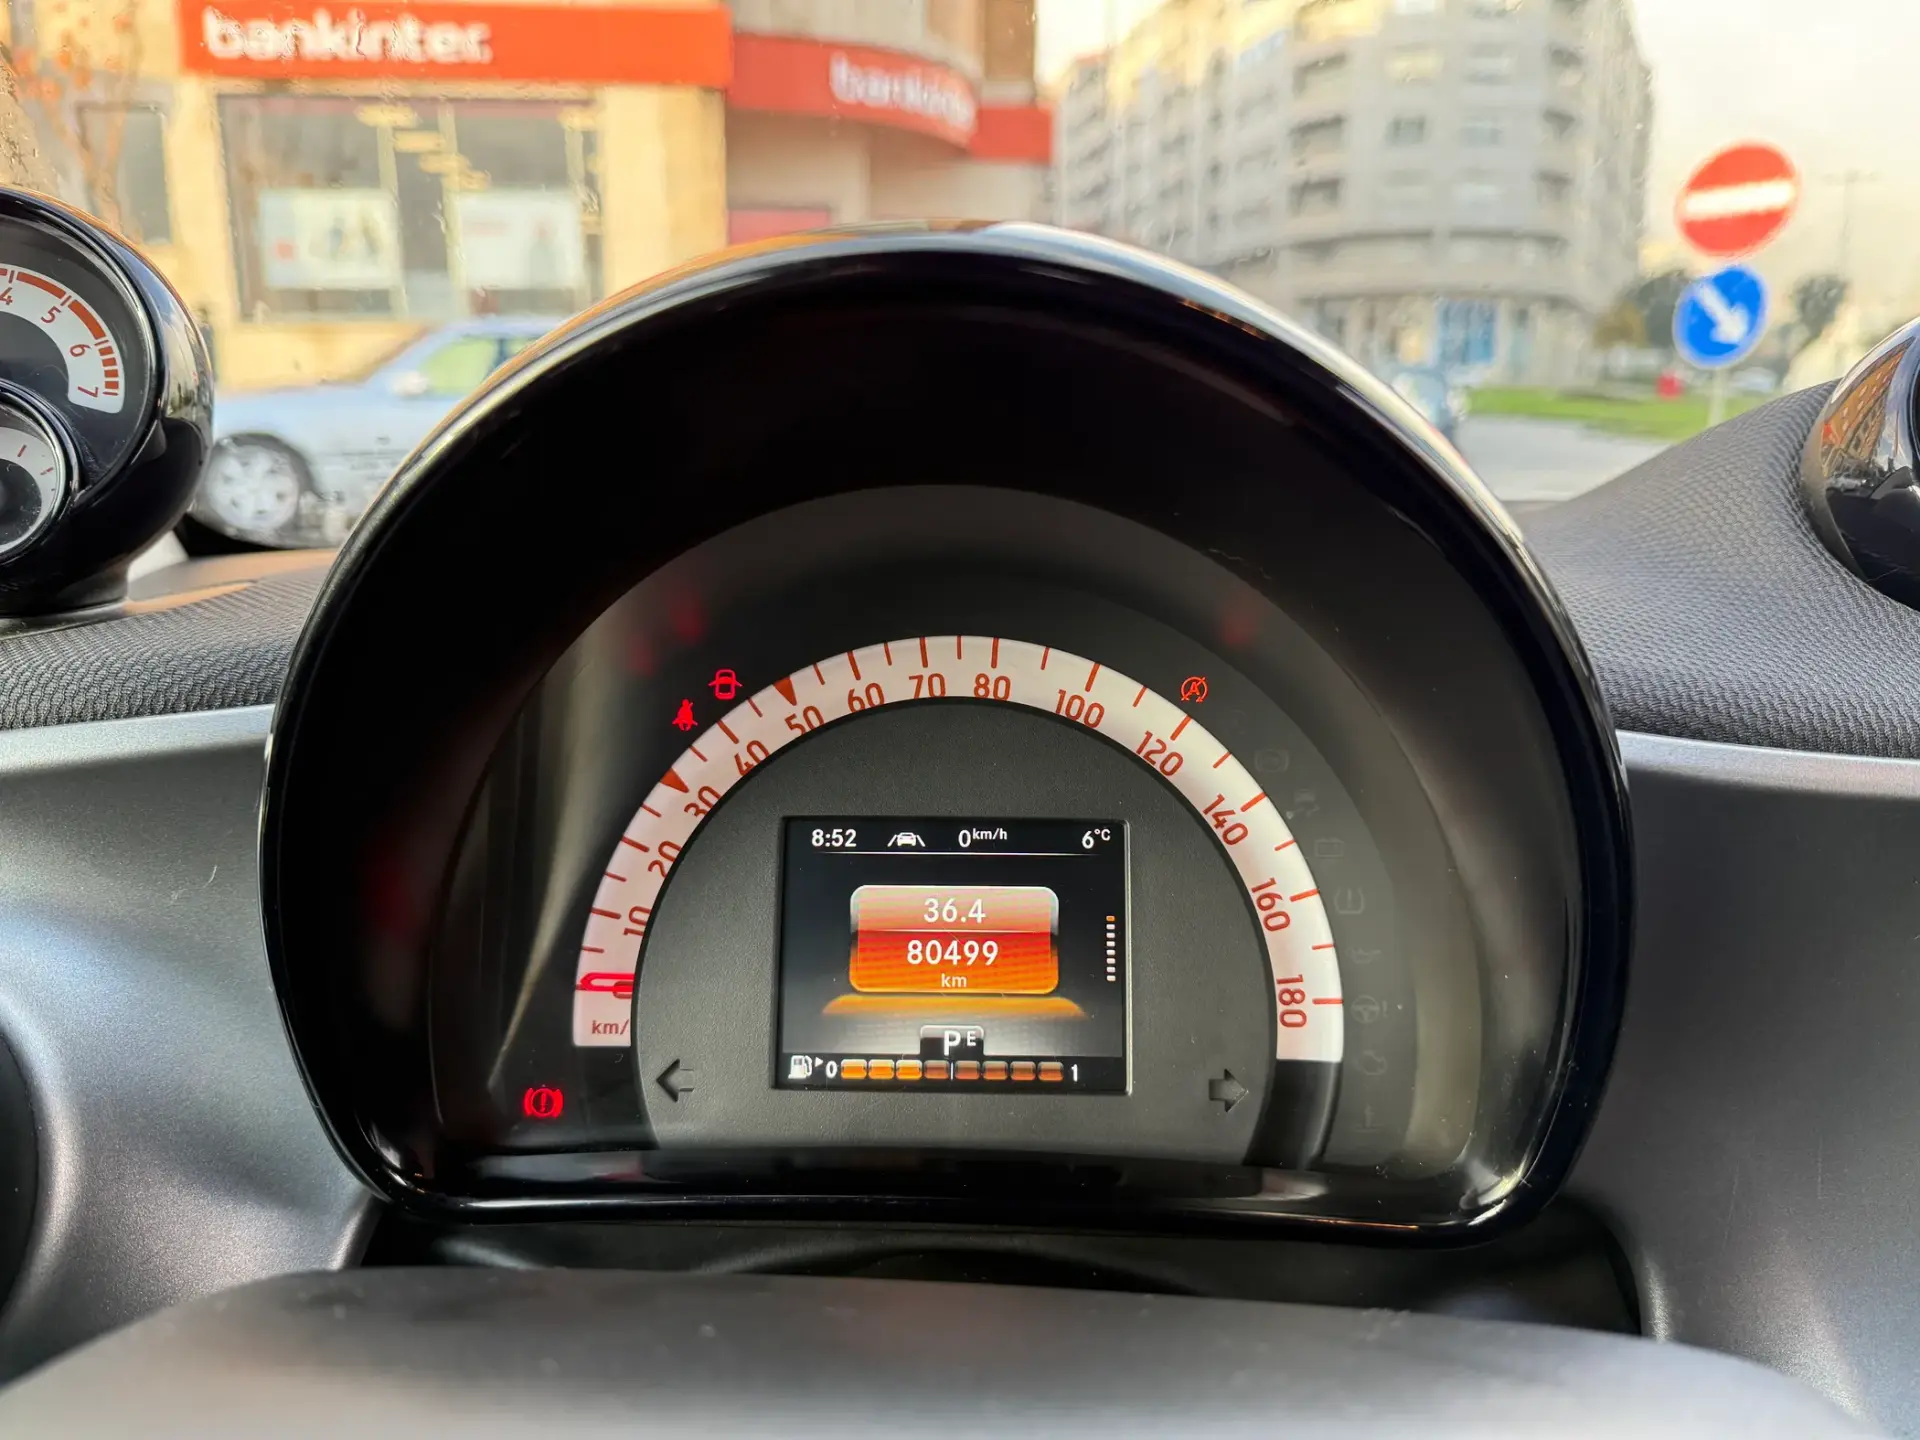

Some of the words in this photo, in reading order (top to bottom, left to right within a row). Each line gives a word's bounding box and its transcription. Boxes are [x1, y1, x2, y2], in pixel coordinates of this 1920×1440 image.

[40, 305, 61, 324] 5
[69, 343, 91, 357] 6
[77, 385, 99, 398] 7
[848, 682, 886, 713] 60
[908, 672, 946, 700] 70
[973, 673, 1011, 702] 80
[784, 705, 825, 736] 50
[1056, 689, 1105, 729] 100
[734, 740, 770, 776] 40
[1136, 730, 1185, 777] 120
[684, 785, 722, 818] 30
[1203, 793, 1248, 845] 140
[812, 829, 857, 848] 8:52
[648, 840, 682, 878] 20
[923, 898, 986, 924] 36.4
[1251, 877, 1291, 932] 160
[623, 905, 652, 937] 10
[906, 940, 999, 966] 80499
[941, 974, 967, 988] km
[1276, 974, 1308, 1029] 180
[826, 1062, 838, 1079] 0
[1070, 1065, 1080, 1083] 1
